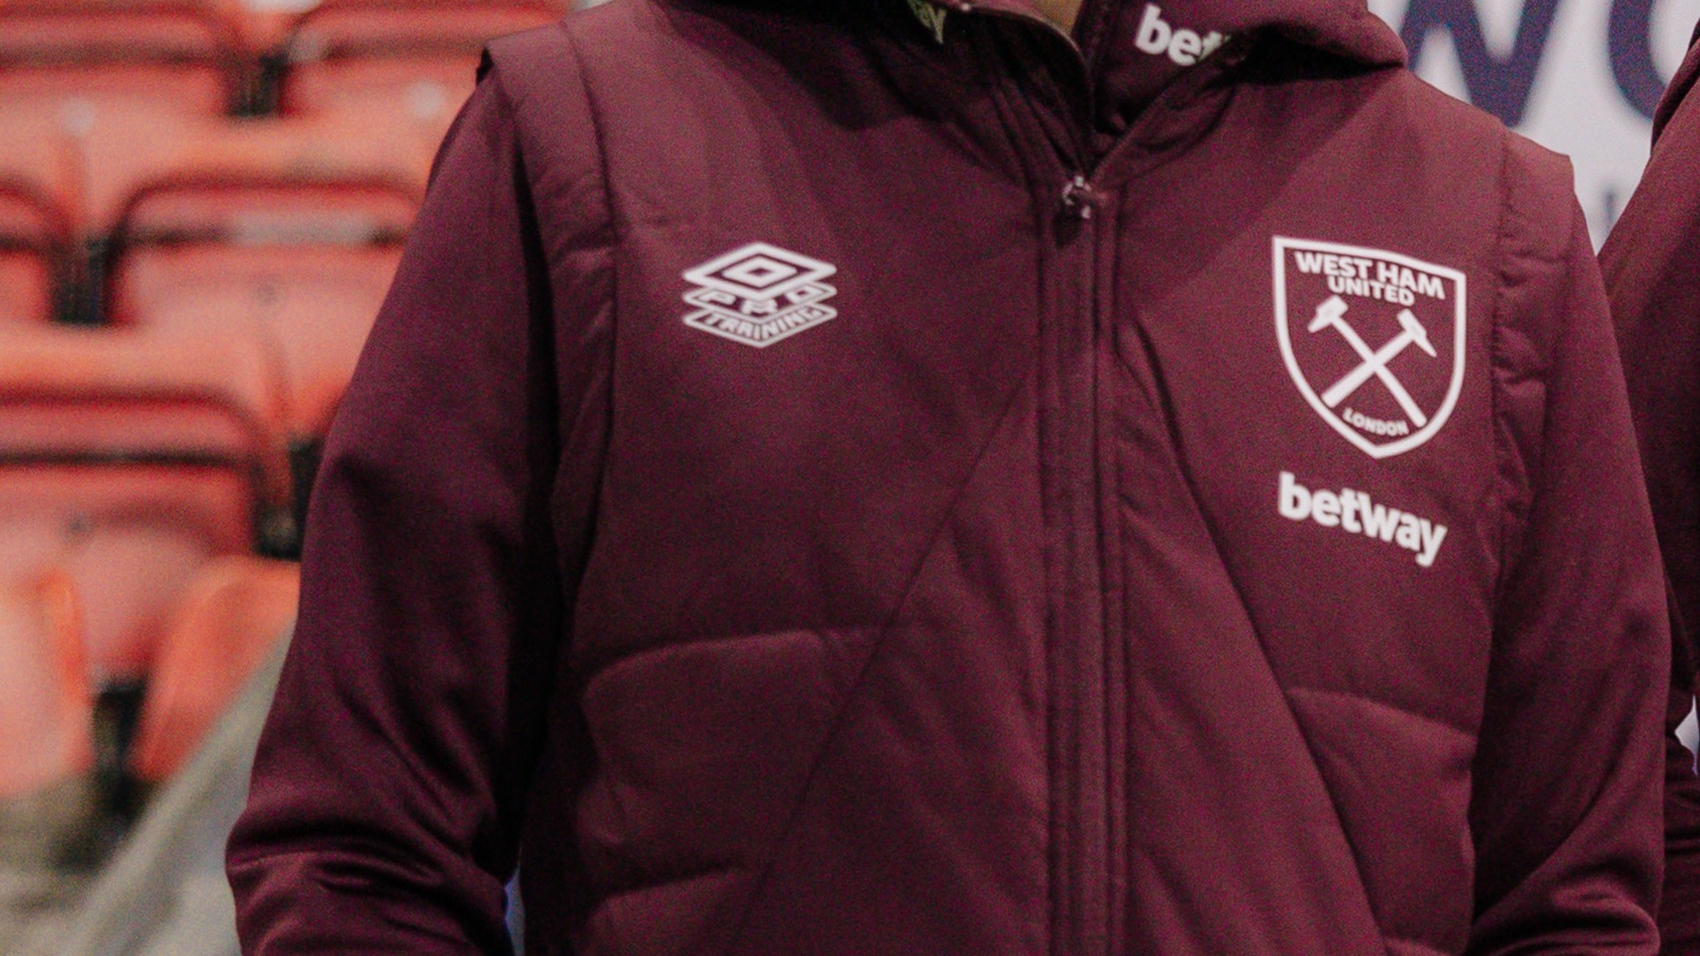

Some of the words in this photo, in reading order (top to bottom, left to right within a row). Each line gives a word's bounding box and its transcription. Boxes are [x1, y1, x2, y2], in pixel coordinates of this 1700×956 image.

[1294, 250, 1373, 279] WEST
[1376, 259, 1446, 300] HAM
[1328, 274, 1415, 307] UNITED
[704, 305, 823, 341] TRAINING
[1342, 407, 1410, 436] LONDON
[1279, 470, 1448, 567] betway
